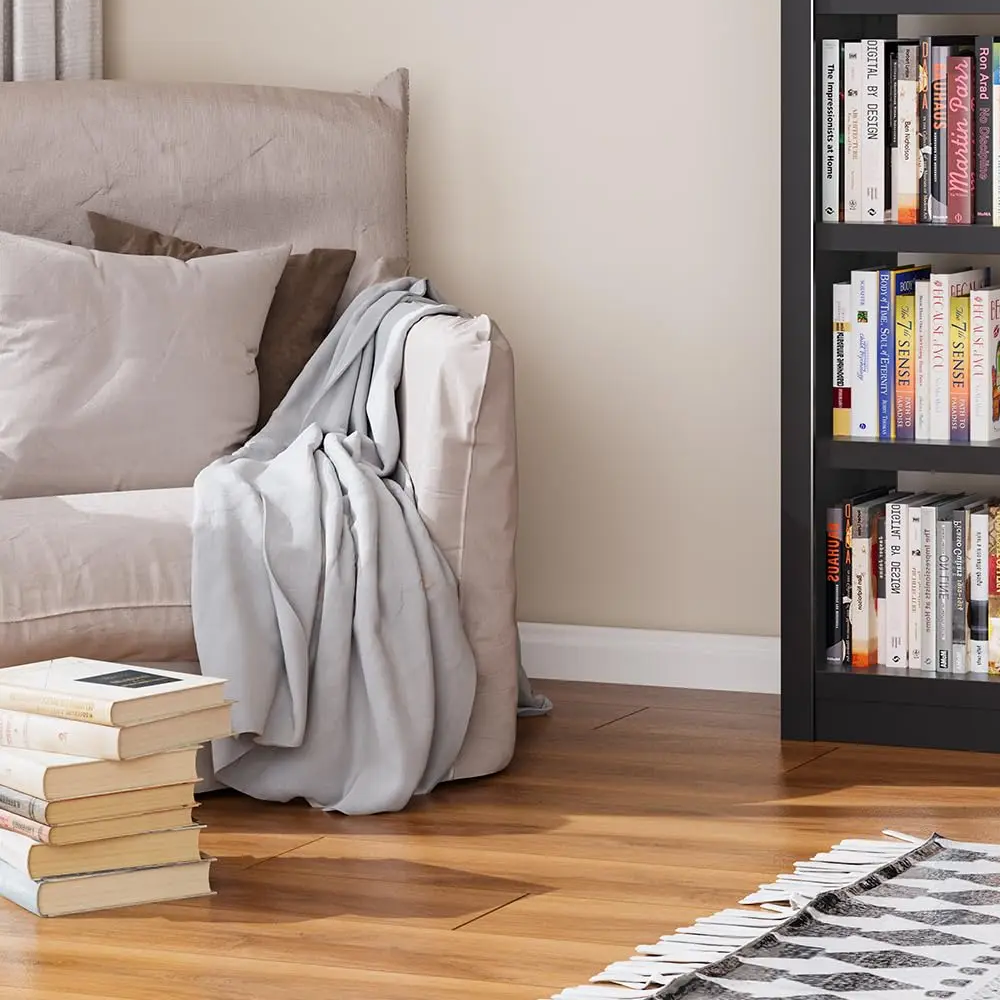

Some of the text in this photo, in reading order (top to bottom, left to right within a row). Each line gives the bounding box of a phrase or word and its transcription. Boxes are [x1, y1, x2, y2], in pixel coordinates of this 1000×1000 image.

[827, 64, 835, 79] The
[867, 40, 878, 140] DIGITAL BY DESIGN
[825, 82, 835, 142] Impressionists
[933, 63, 946, 130] BAUHAUS
[977, 47, 990, 180] Ron Arad No Discipline
[827, 145, 834, 153] at
[949, 61, 968, 193] Martin Parr
[880, 274, 890, 295] BODY
[880, 305, 890, 325] TIME,
[934, 290, 943, 336] BECAUSE
[973, 304, 984, 350] BECAUSE
[880, 328, 890, 349] SOUL
[897, 306, 912, 386] The 7th SENSE
[951, 307, 966, 388] The 7th SENSE
[880, 358, 890, 395] ETERNITY
[906, 418, 911, 426] TO
[960, 419, 965, 428] TO
